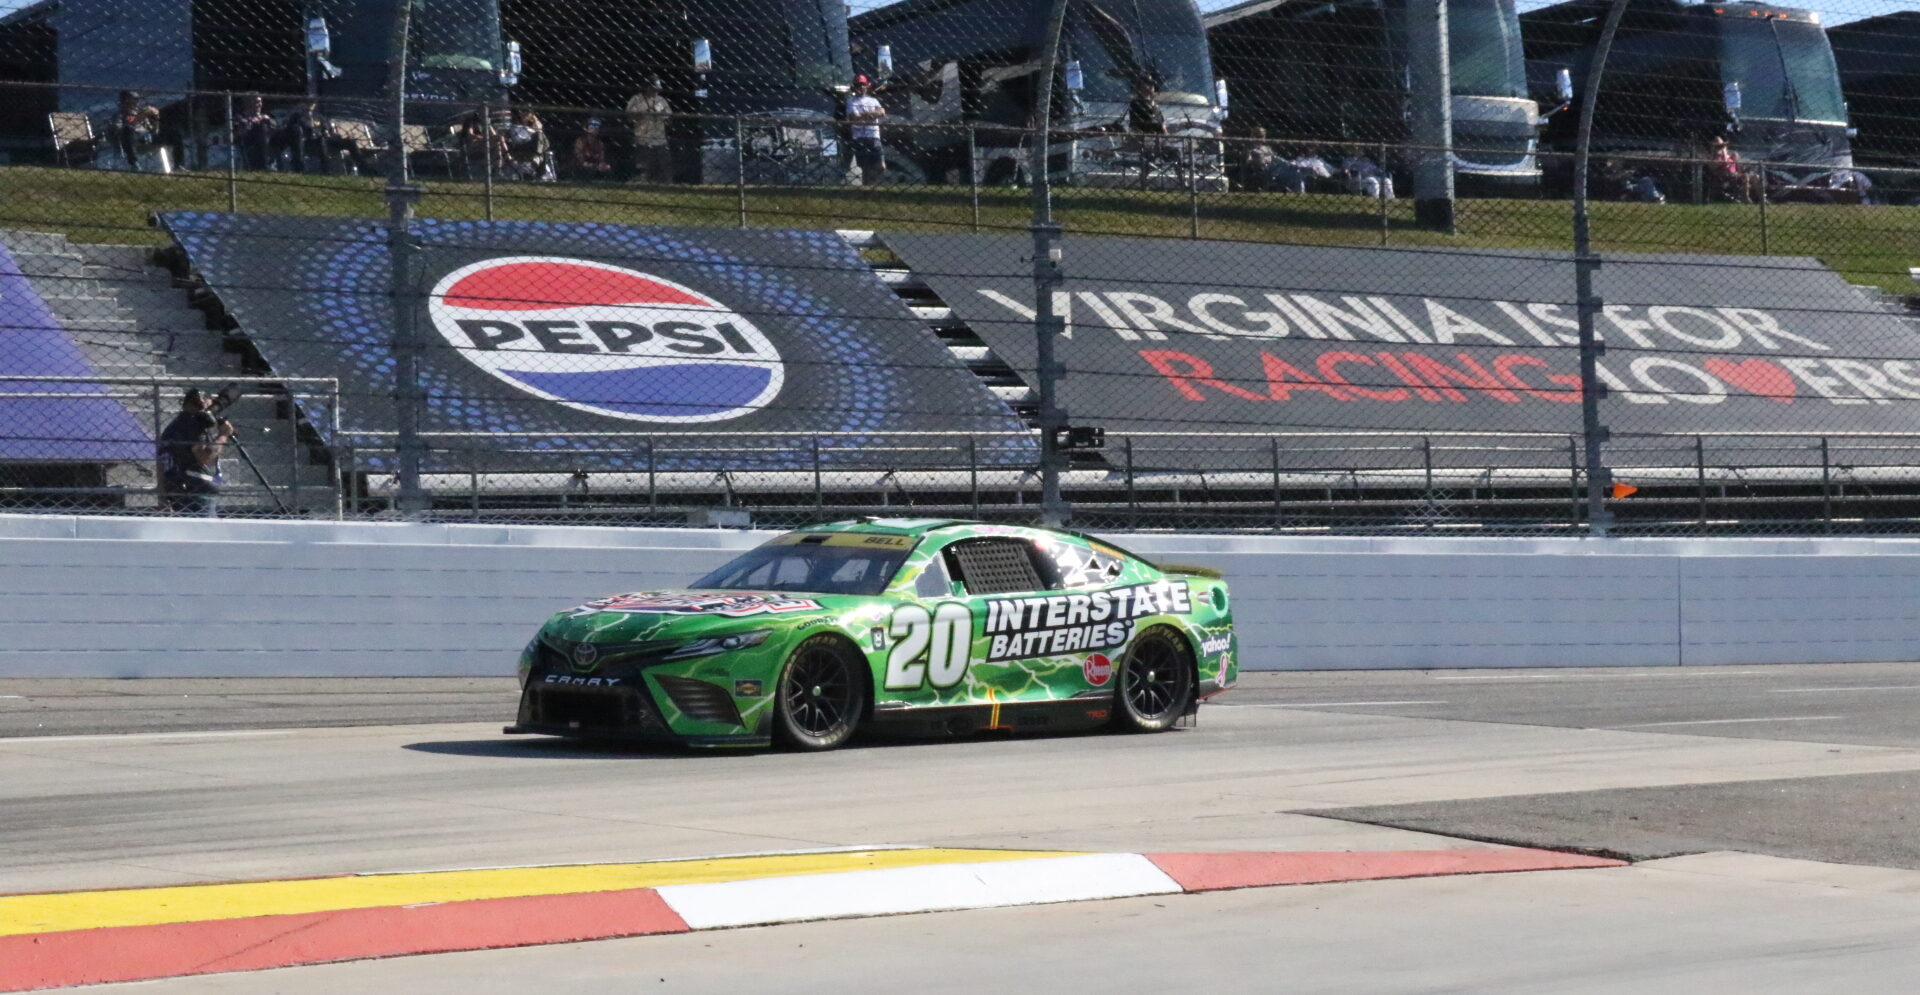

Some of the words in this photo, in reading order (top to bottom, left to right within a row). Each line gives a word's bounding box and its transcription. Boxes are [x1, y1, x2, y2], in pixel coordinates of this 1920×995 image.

[454, 319, 757, 355] PEPSI
[977, 289, 1516, 346] VIRGINIA
[1496, 301, 1603, 346] IS
[1602, 304, 1832, 350] FOR
[1139, 349, 1583, 402] RACING
[864, 536, 904, 546] BELL
[987, 582, 1191, 632] INTERSTATE
[885, 602, 973, 690] 20
[990, 621, 1126, 659] BATTERIES
[1202, 633, 1231, 657] yahoo!
